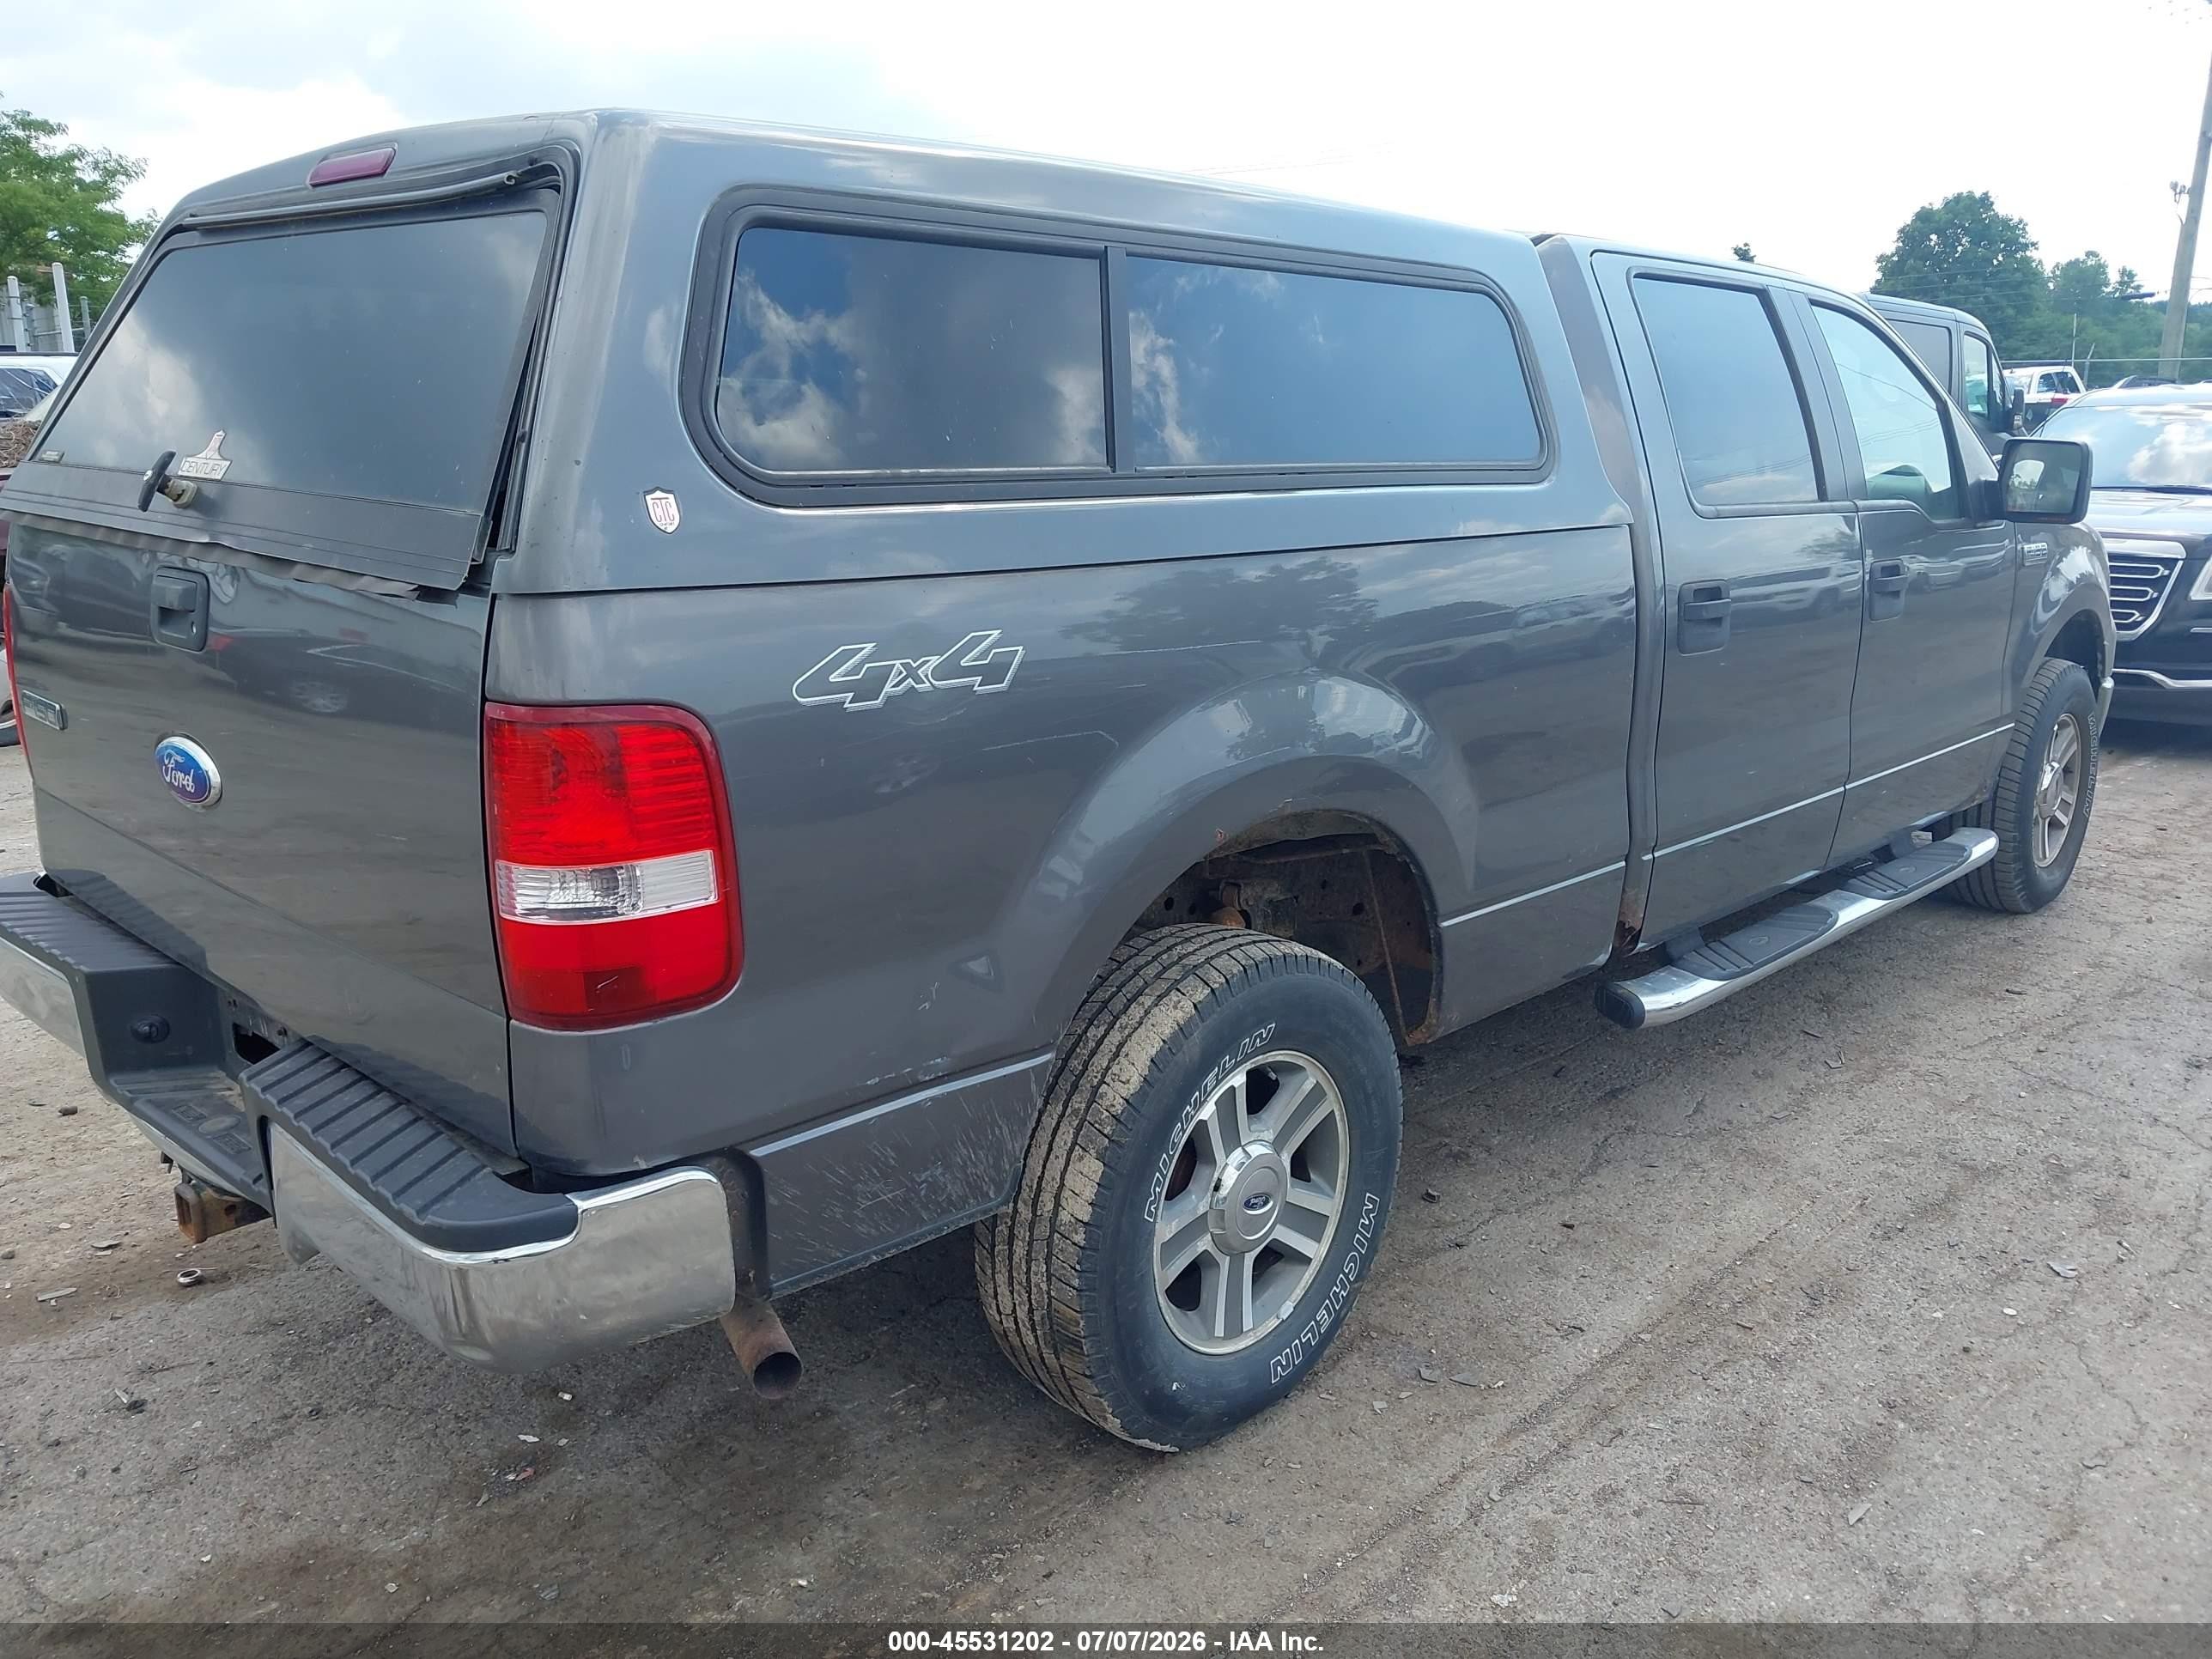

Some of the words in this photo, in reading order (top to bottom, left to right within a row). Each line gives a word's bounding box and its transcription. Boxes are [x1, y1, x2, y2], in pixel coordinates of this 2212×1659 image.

[181, 459, 228, 477] CENTURY
[792, 629, 1026, 713] 4x4
[161, 749, 196, 794] Ford
[1144, 1023, 1277, 1223] MICHELIN
[1269, 1192, 1381, 1385] MICHELIN
